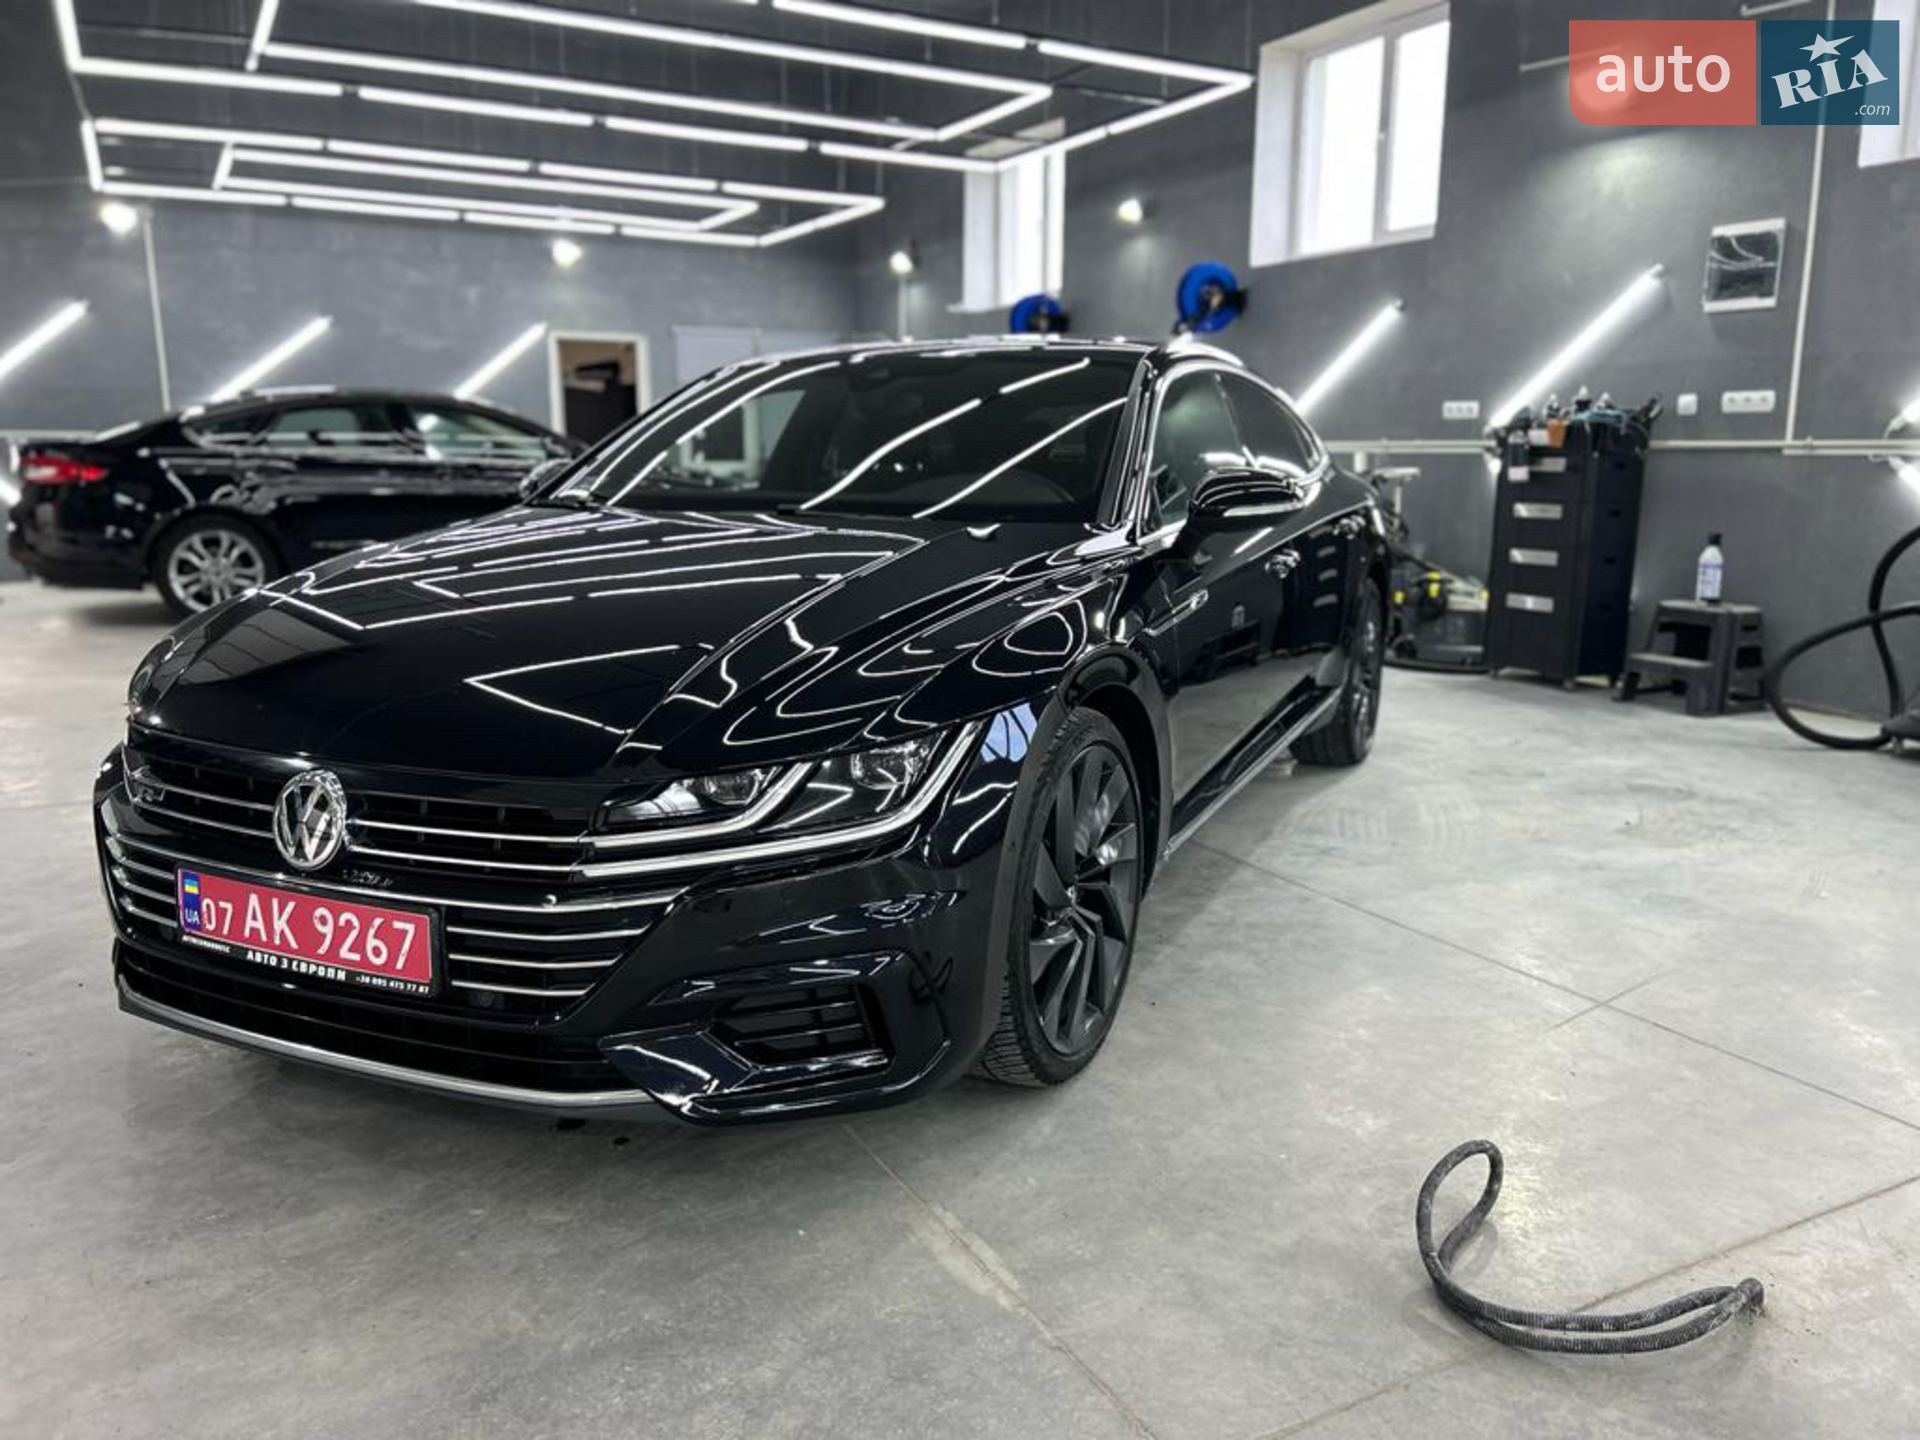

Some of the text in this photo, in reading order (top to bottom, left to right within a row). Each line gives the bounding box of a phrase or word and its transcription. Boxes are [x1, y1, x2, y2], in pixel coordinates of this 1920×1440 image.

[184, 908, 200, 925] UA
[202, 897, 234, 935] 07
[312, 906, 416, 970] 9267
[246, 949, 278, 967] АВТО
[291, 960, 346, 981] ЄВРОПИ
